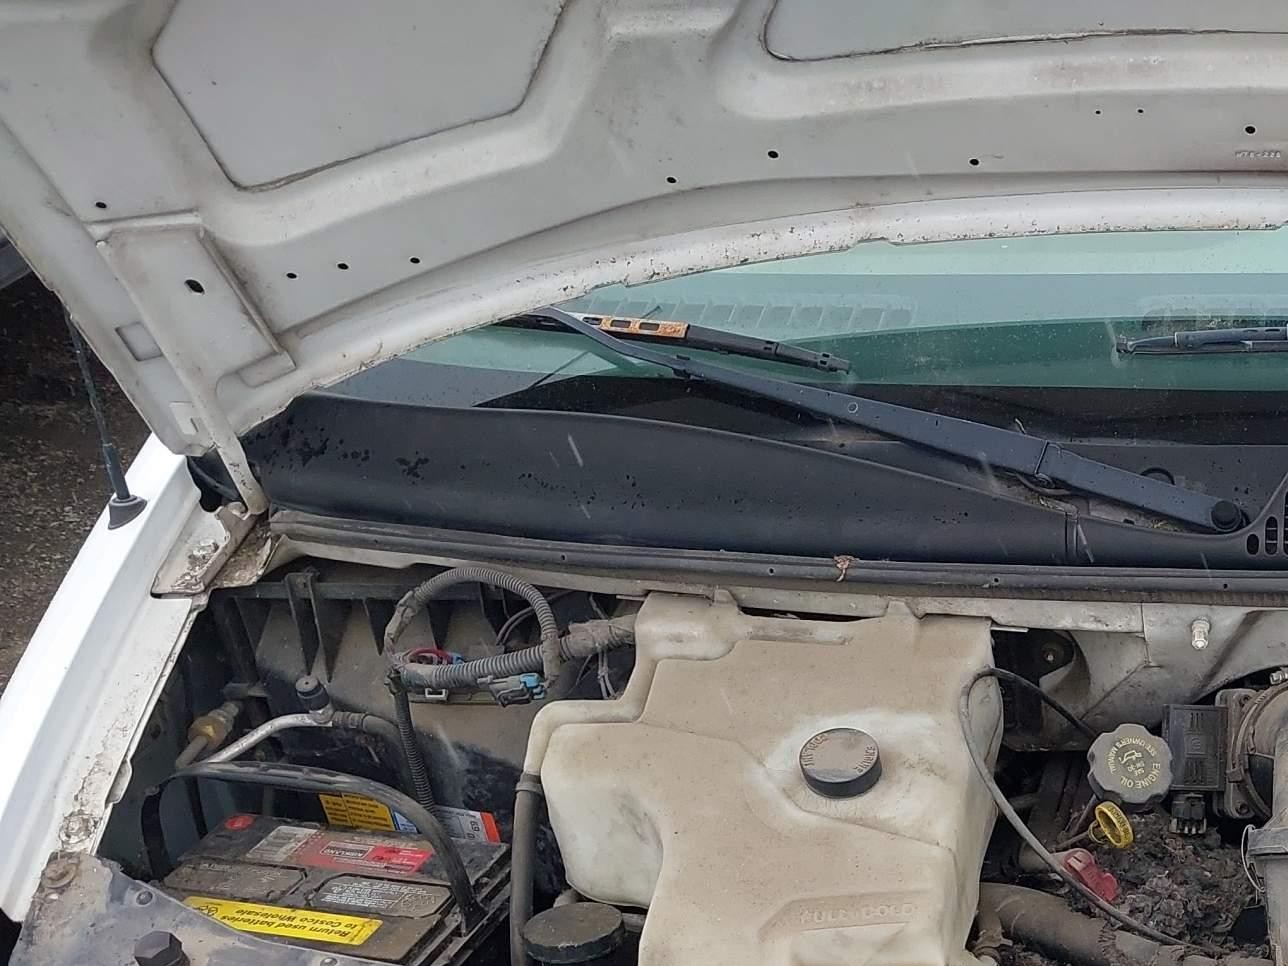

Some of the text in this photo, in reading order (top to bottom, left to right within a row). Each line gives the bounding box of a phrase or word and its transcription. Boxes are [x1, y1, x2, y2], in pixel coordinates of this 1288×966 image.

[1120, 763, 1161, 789] ENGINE OIL
[236, 909, 297, 923] Wholesale
[301, 916, 343, 929] Costco
[220, 914, 351, 938] Return used batteries
